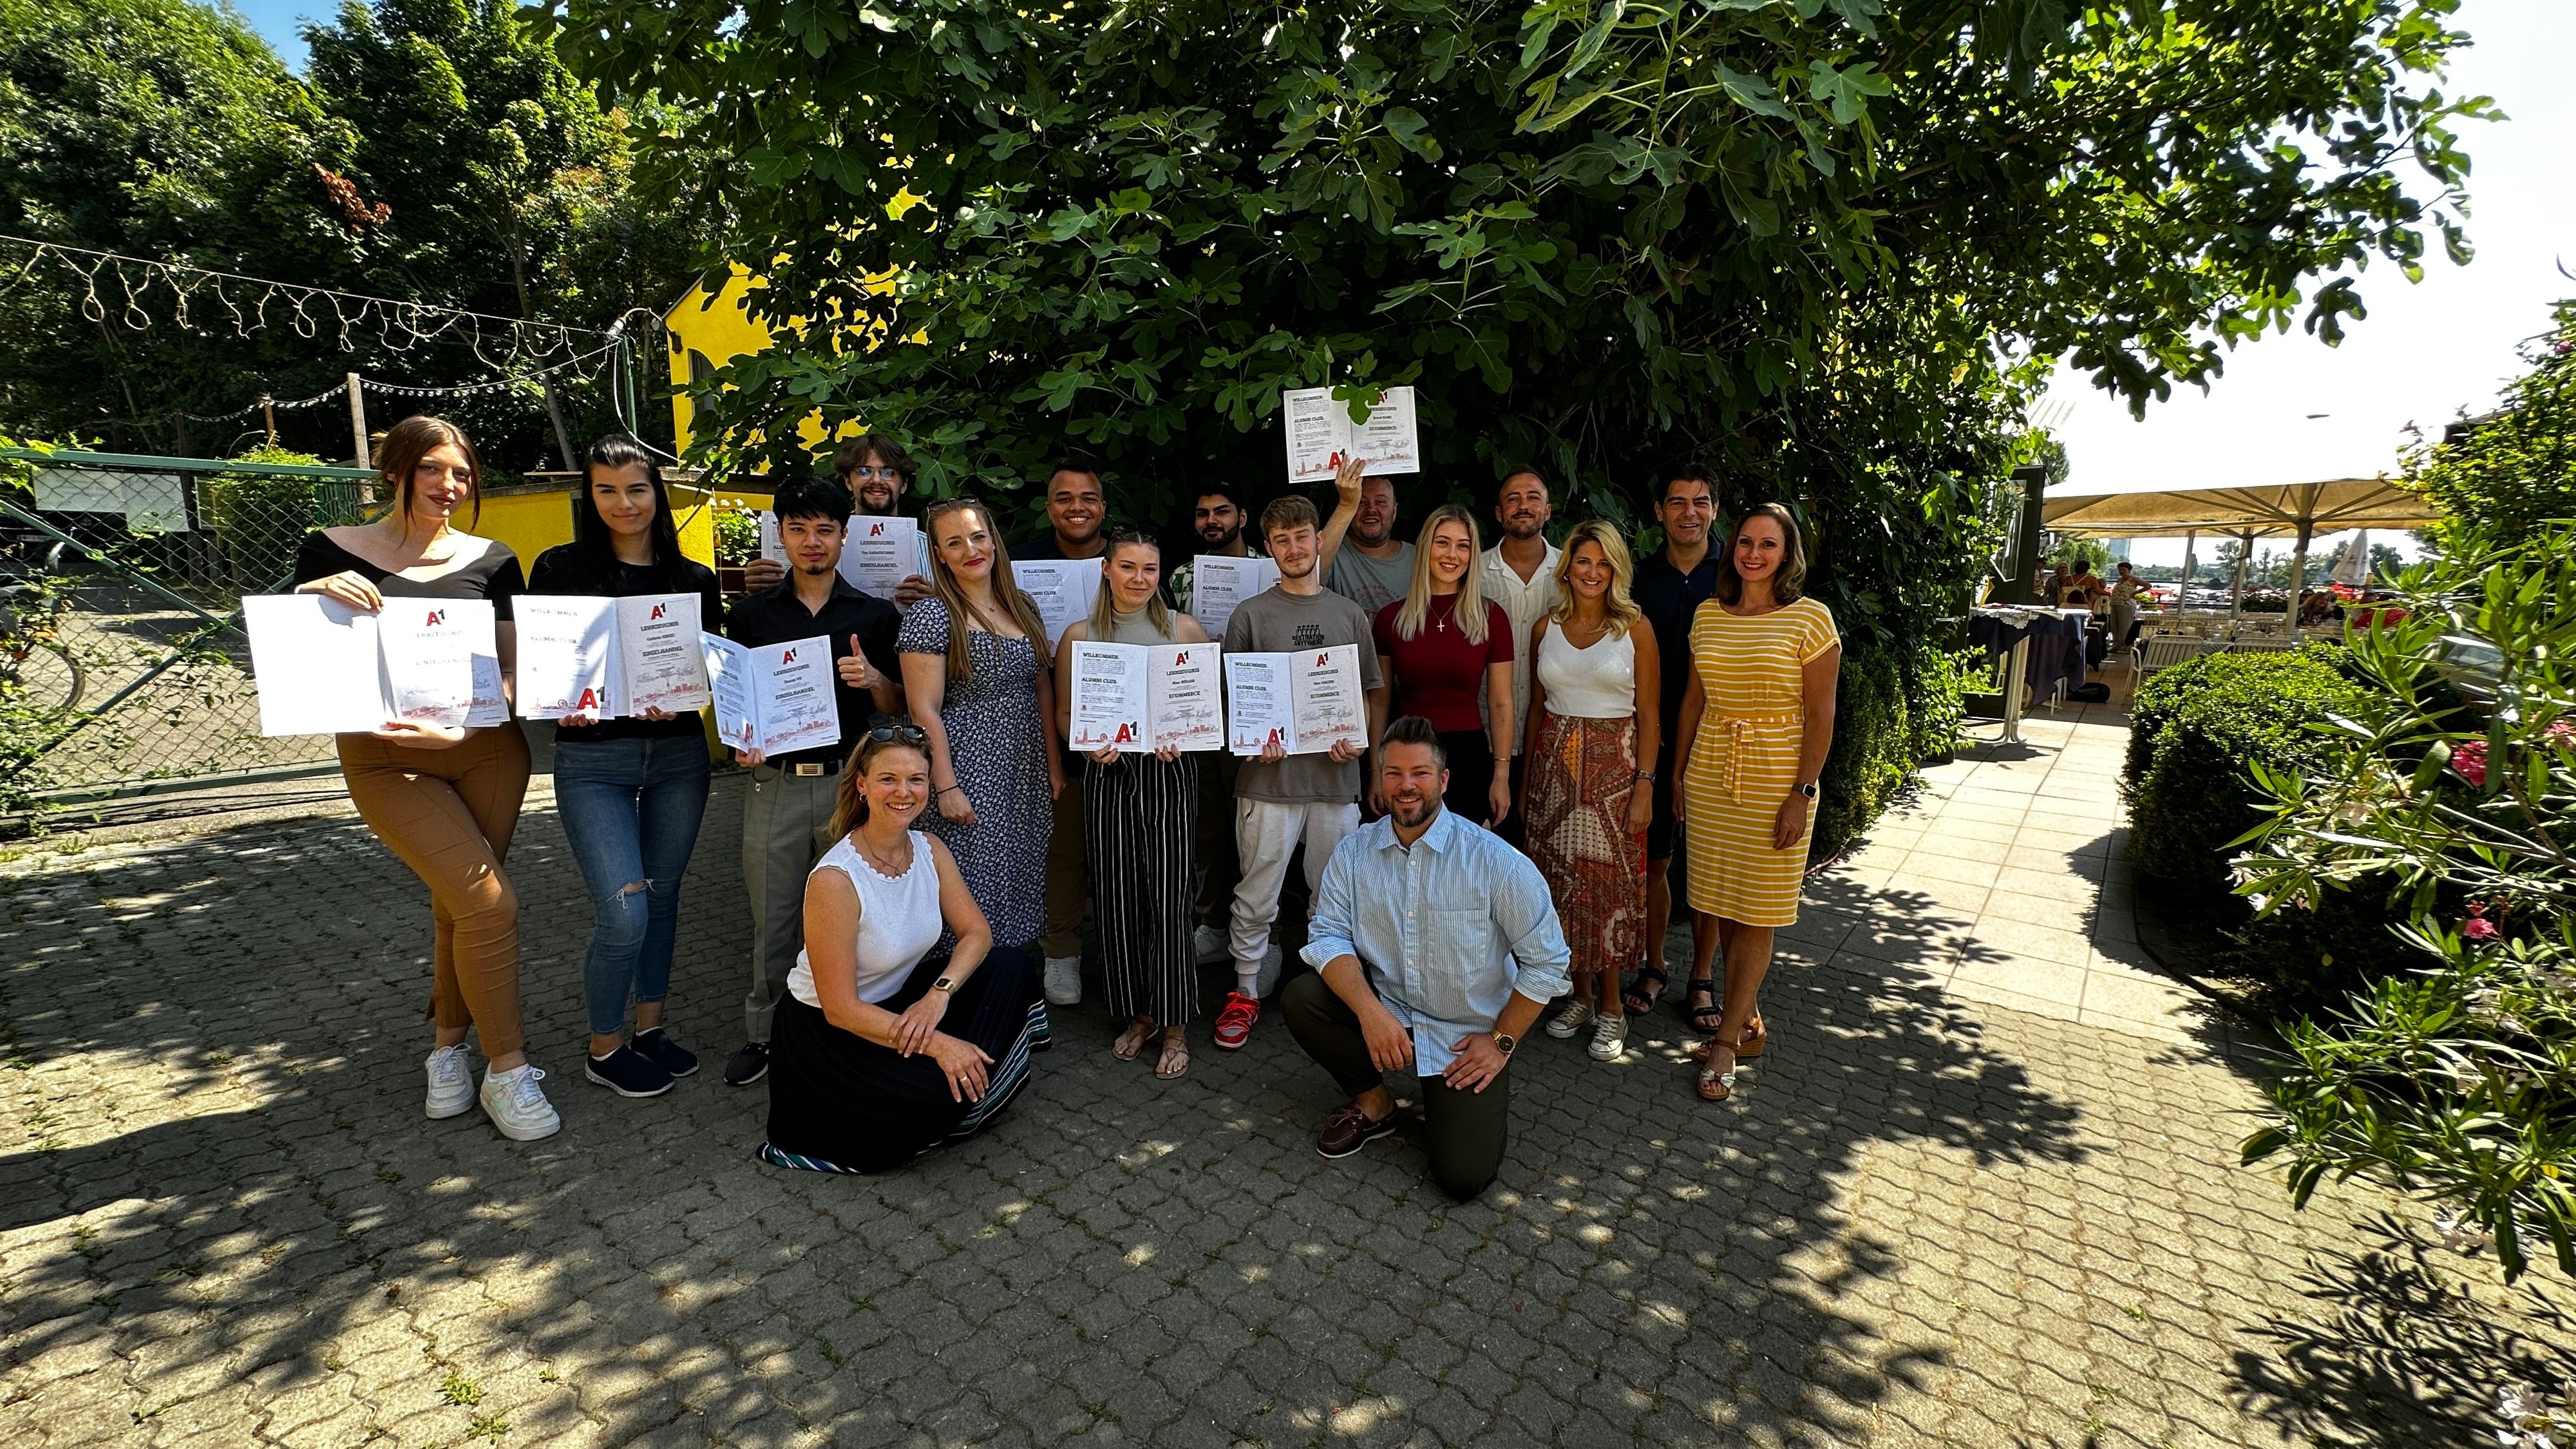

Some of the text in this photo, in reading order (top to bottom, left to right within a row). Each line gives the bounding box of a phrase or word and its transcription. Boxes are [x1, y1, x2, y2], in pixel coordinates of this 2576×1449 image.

[1329, 448, 1345, 469] A1
[870, 522, 884, 536] A1
[426, 609, 445, 627] A1
[650, 602, 666, 620] A1
[783, 647, 797, 665] A1
[1175, 650, 1189, 666] A1
[1316, 652, 1329, 667] A1
[577, 686, 605, 710] A1
[1115, 721, 1138, 743] A1
[1267, 726, 1285, 746] A1
